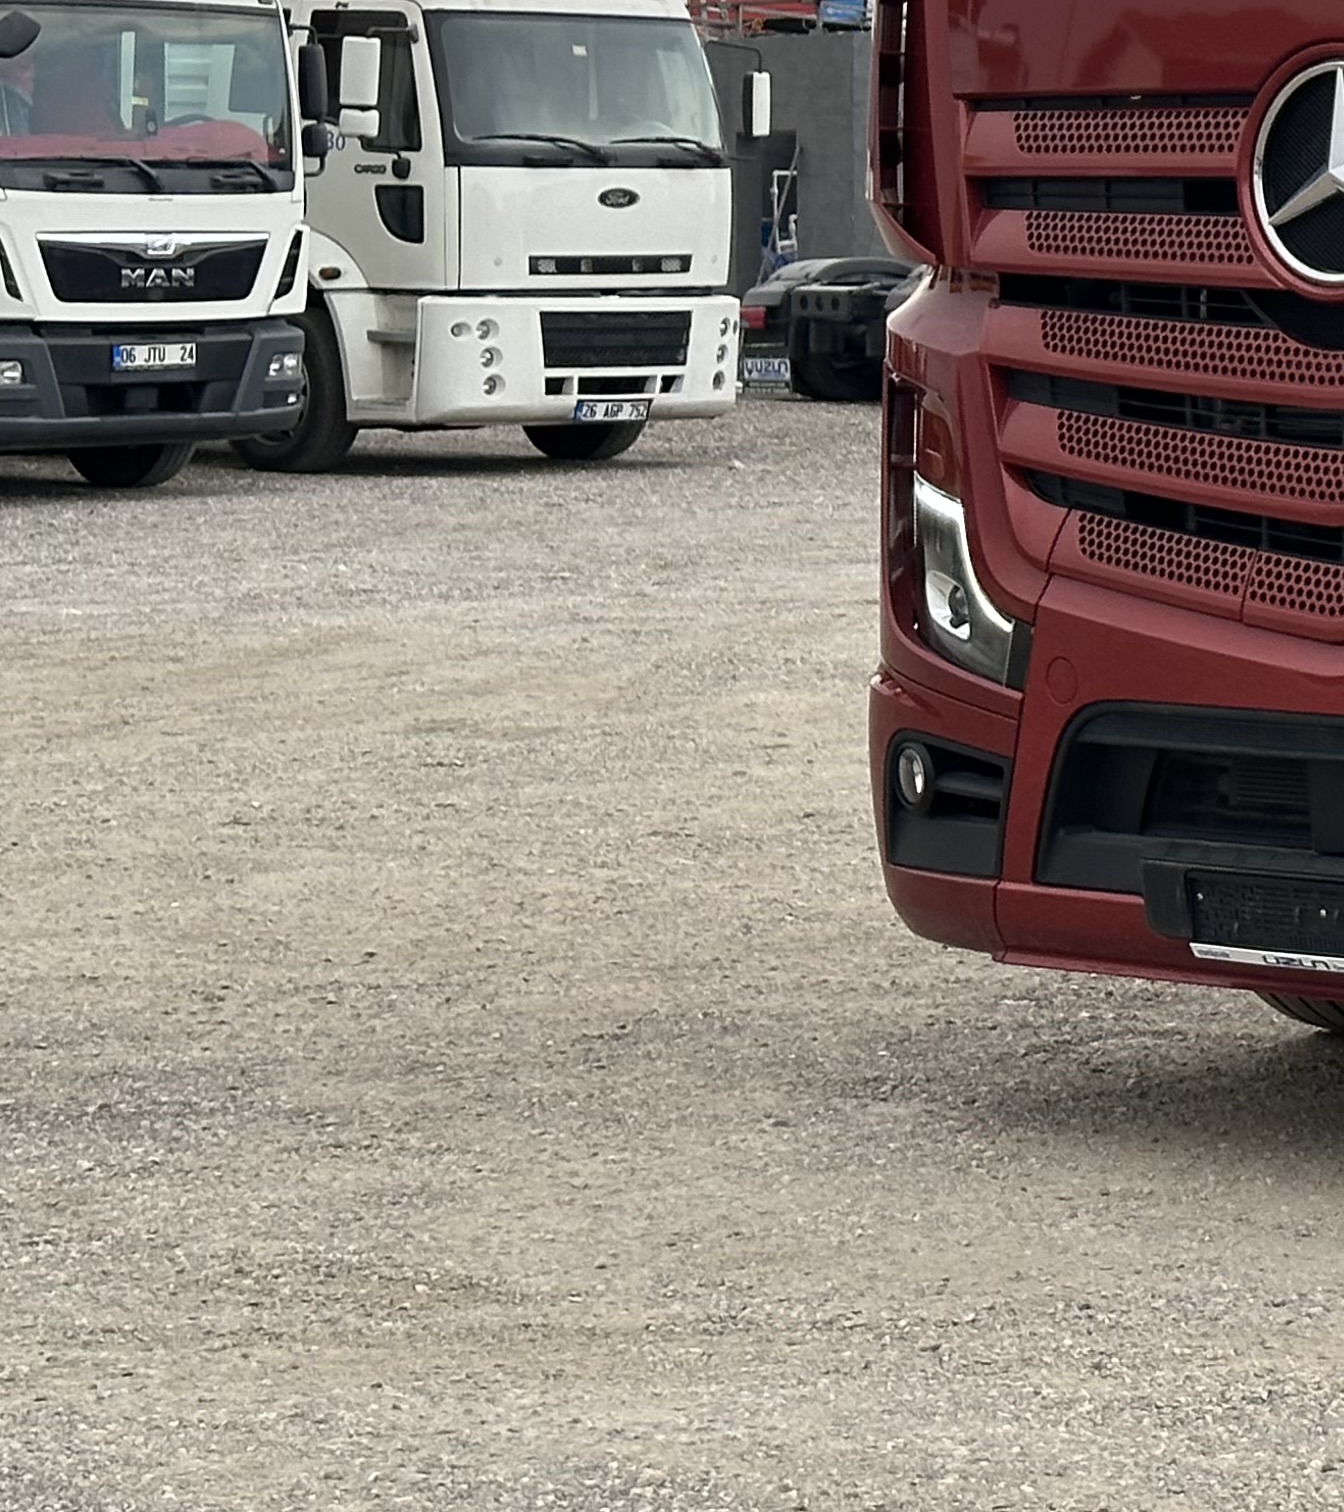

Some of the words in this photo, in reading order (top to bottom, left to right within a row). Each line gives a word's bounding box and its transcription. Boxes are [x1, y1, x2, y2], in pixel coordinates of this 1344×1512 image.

[120, 268, 195, 288] MAN
[121, 347, 136, 364] 06
[144, 346, 166, 363] JTU
[180, 345, 194, 363] 24
[583, 403, 598, 418] 26
